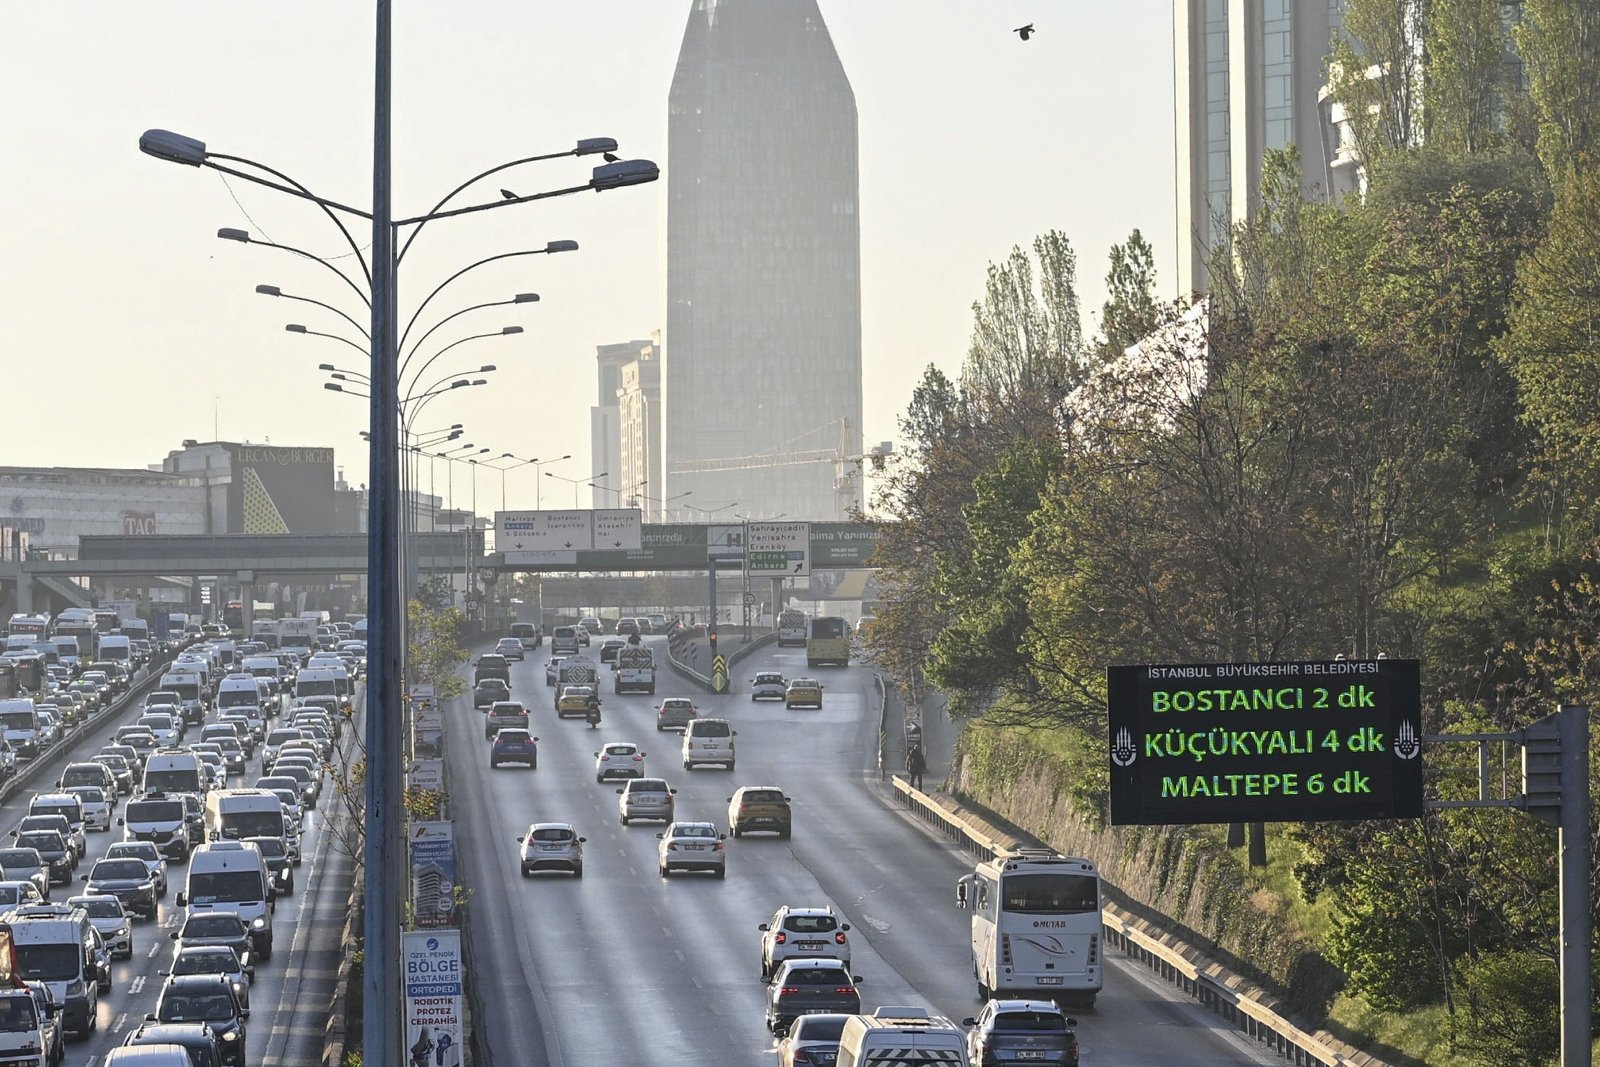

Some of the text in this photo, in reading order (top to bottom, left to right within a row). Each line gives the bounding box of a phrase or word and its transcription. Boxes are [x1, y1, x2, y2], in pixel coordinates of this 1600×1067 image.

[1148, 666, 1212, 679] İSTANBUL
[1304, 661, 1380, 676] BELEDİYESİ
[1151, 685, 1376, 713] BOSTANCI 2 dk
[1145, 726, 1385, 762] KÜÇÜKYALI 4 dk
[1161, 770, 1371, 798] MALTEPE 6 dk
[1039, 920, 1066, 928] MUYAB
[410, 950, 455, 959] ÖZEL PENDİK
[408, 958, 458, 973] BÖLGE
[408, 973, 459, 983] HASTANESİ
[411, 984, 457, 994] ORTOPEDİ
[414, 996, 454, 1006] ROBOTİK
[416, 1007, 452, 1016] PROTEZ
[411, 1015, 458, 1026] CERRAHİSİ
